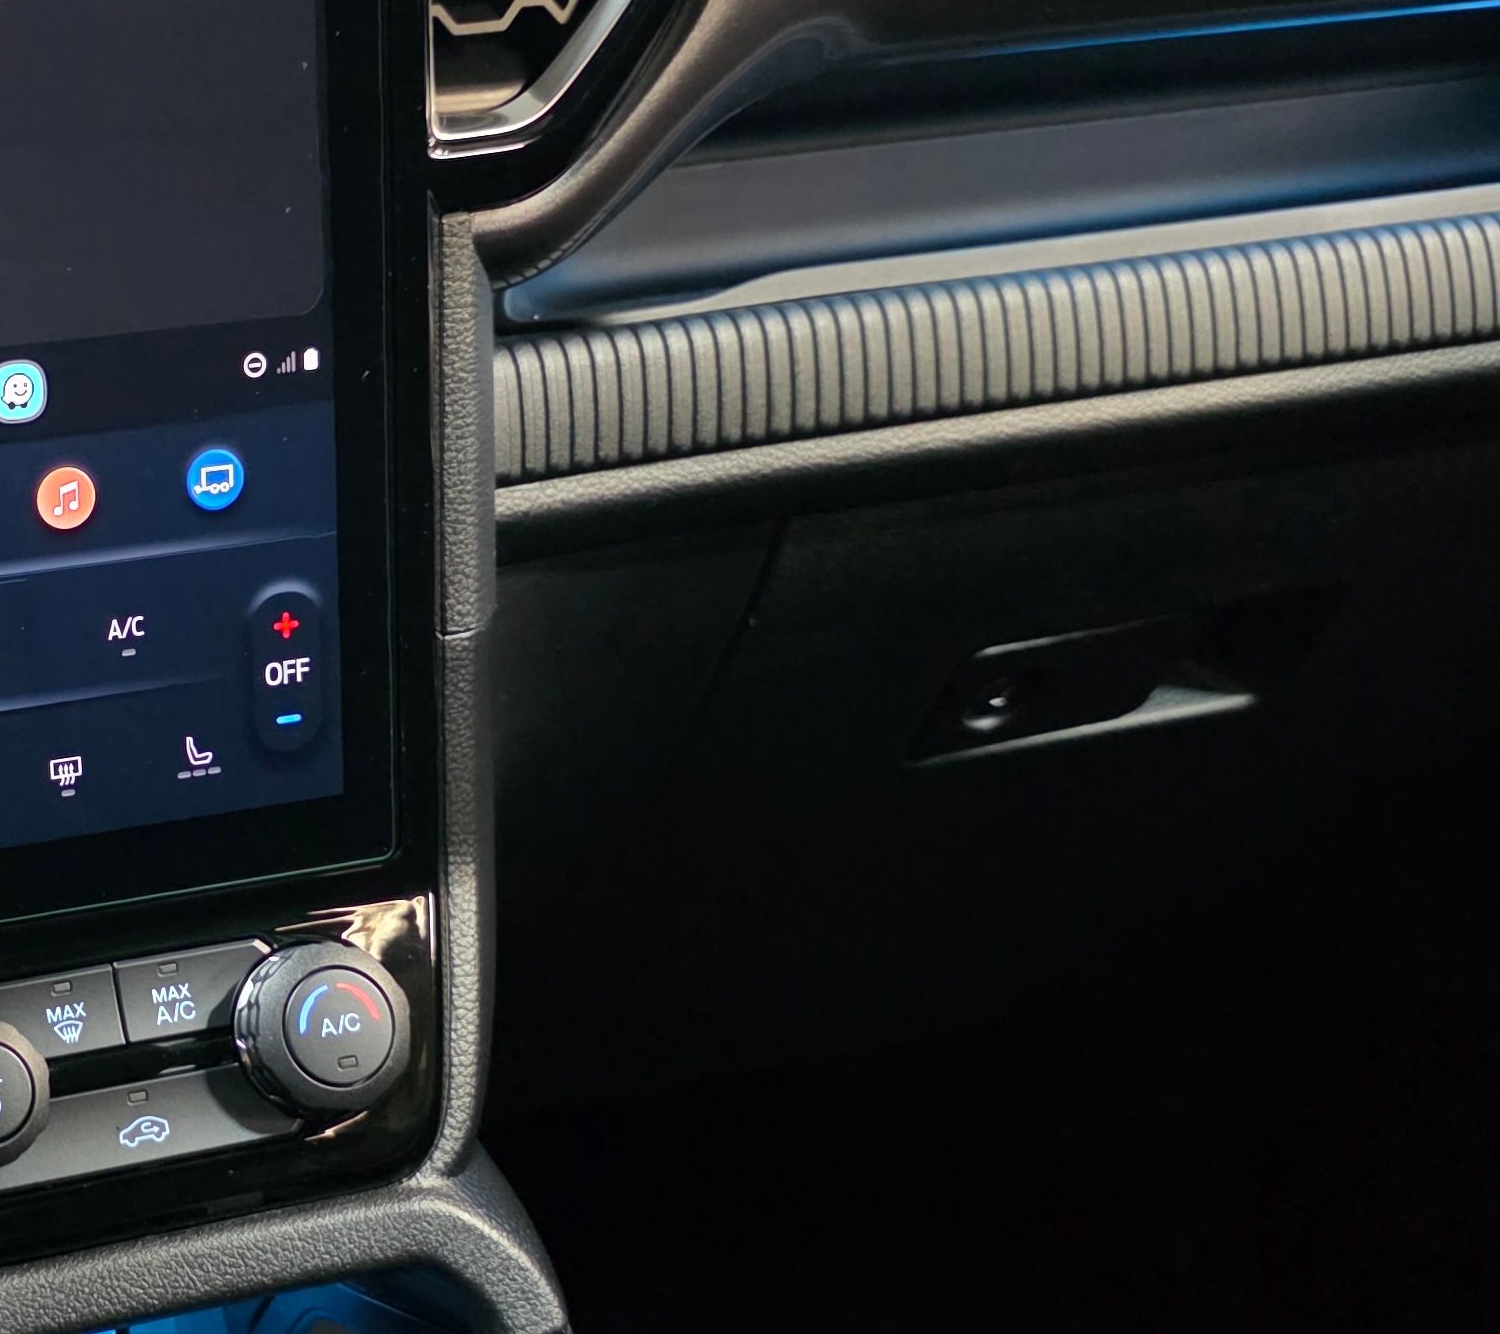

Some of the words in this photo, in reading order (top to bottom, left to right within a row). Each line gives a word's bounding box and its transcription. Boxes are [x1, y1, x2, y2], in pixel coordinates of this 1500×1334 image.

[106, 613, 146, 642] A/C
[263, 657, 311, 687] OFF
[151, 982, 192, 1003] MAX
[45, 1001, 87, 1024] MAX
[156, 1000, 197, 1026] A/C
[320, 1012, 362, 1038] A/C
